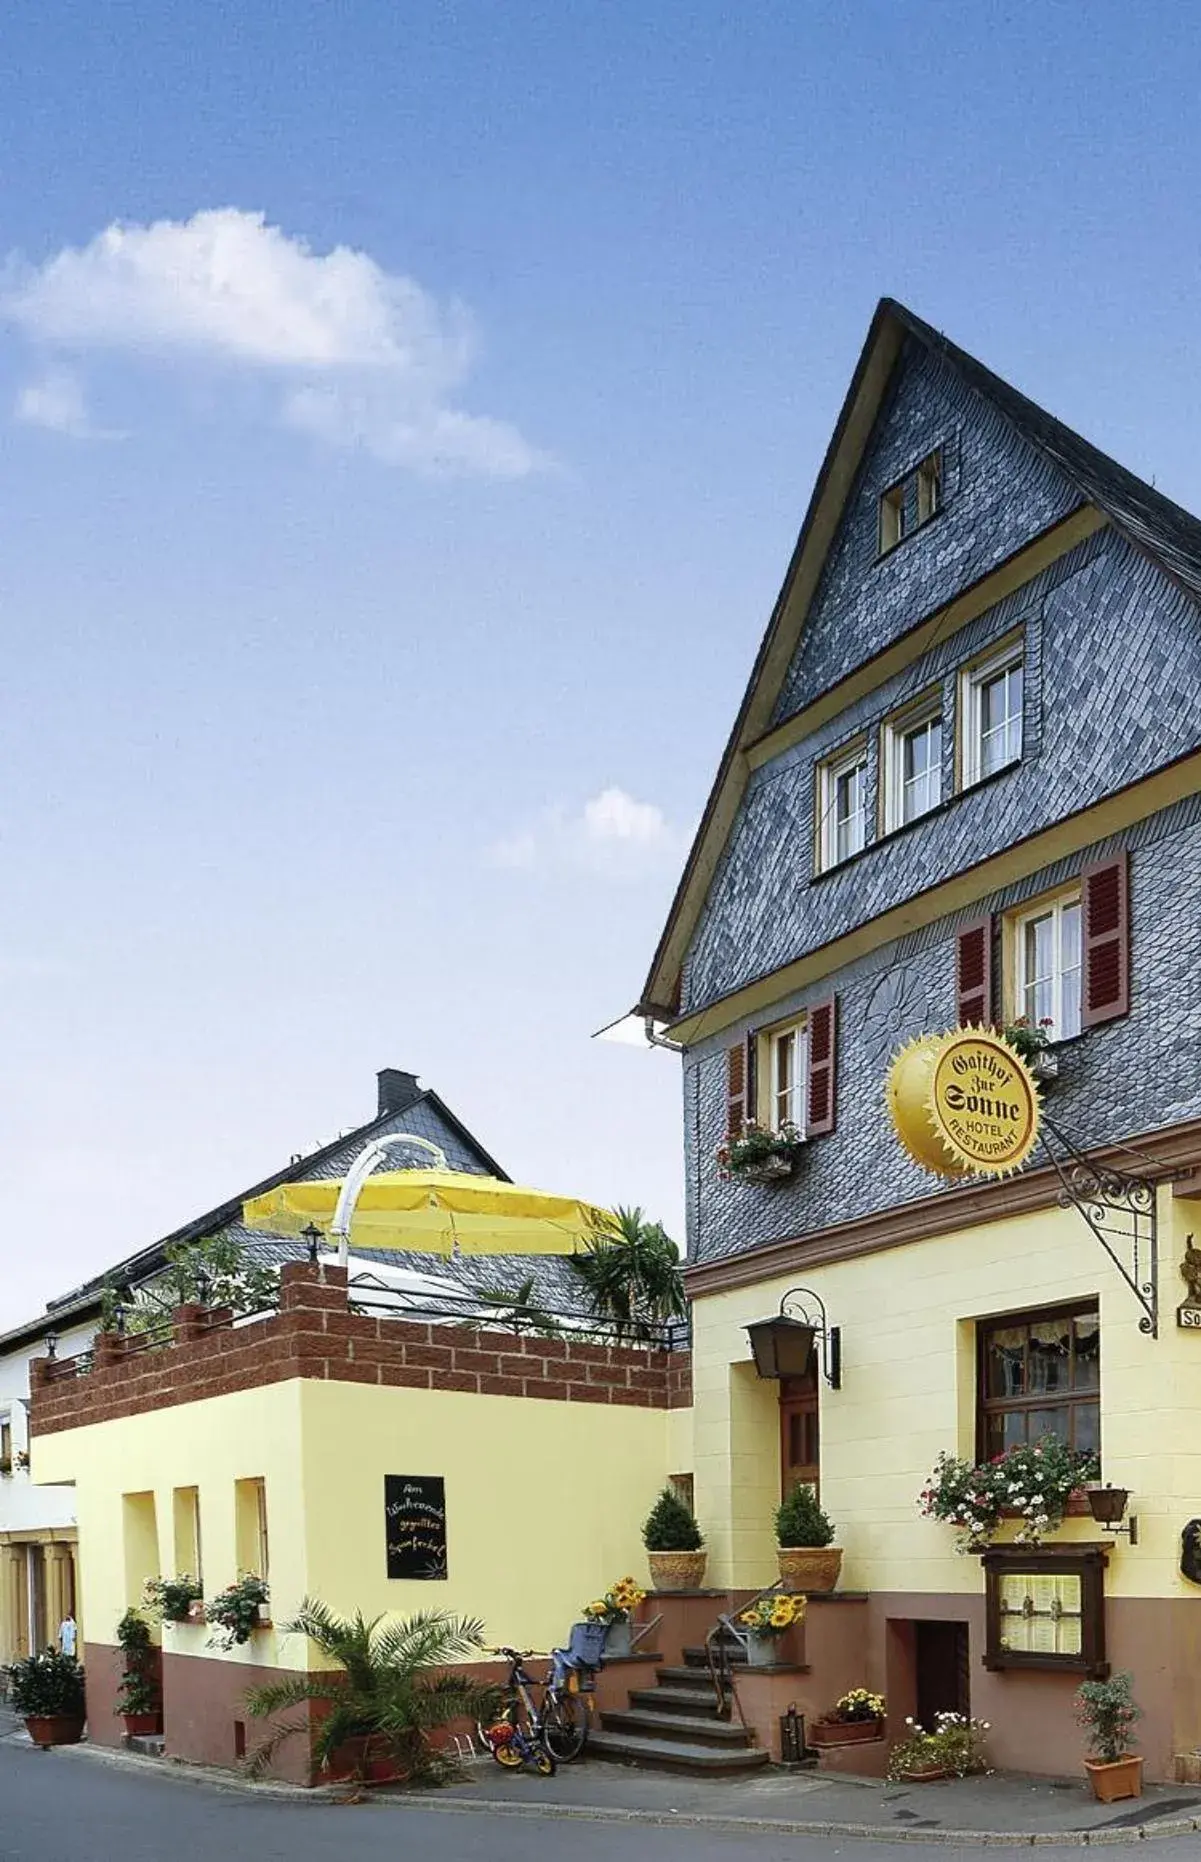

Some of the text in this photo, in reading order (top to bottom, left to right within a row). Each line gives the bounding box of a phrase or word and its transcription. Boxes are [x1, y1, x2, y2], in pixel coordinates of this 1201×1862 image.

[952, 1051, 1013, 1088] Gasthof
[944, 1084, 1020, 1121] Sonne
[949, 1119, 1018, 1155] RESTAURANT
[966, 1120, 1003, 1138] HOTEL
